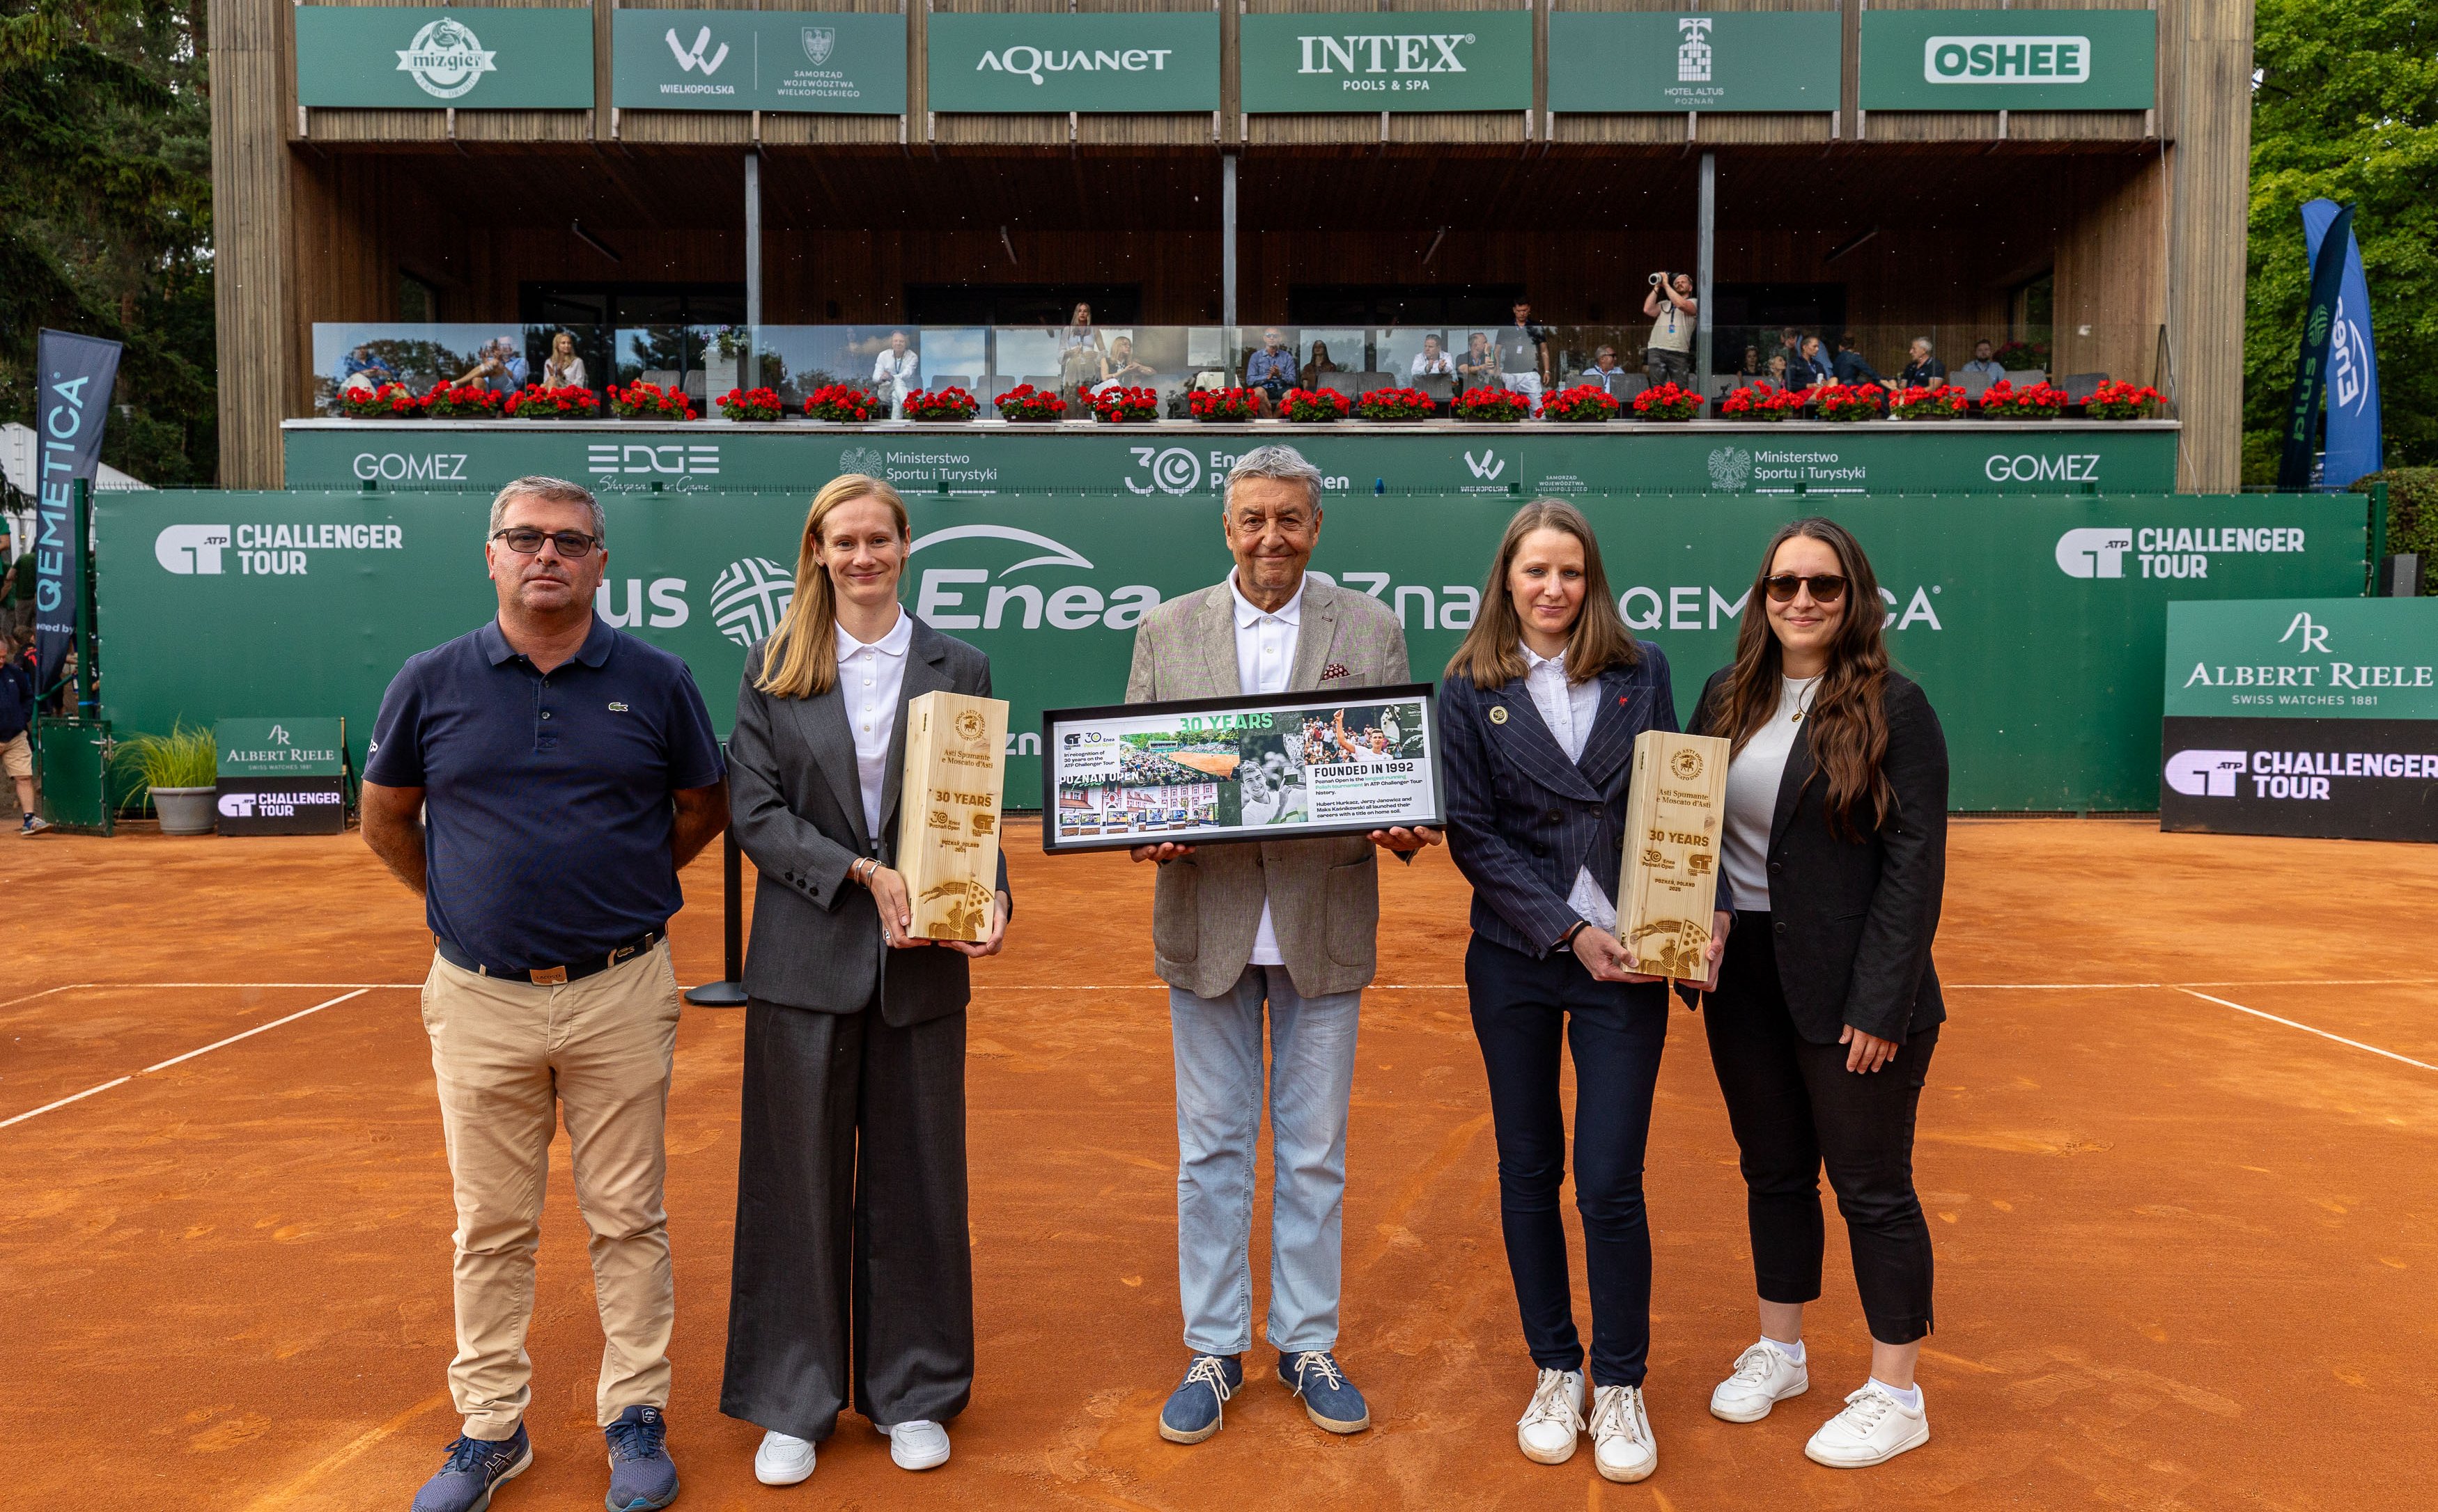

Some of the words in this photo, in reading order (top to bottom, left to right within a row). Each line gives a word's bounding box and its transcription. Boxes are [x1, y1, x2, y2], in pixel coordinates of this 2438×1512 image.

[413, 52, 481, 70] mizgier
[1934, 43, 2080, 77] OSHEE
[794, 70, 843, 79] SAMORZĄD
[660, 84, 735, 94] WIELKOPOLSKA
[784, 78, 854, 88] WOJEWÓDZTWA
[1343, 80, 1385, 91] POOLS
[1391, 80, 1401, 91] &
[1406, 80, 1429, 91] SPA
[777, 88, 860, 98] WIELKOPOLSKIEGO
[1664, 87, 1694, 95] HOTEL
[1695, 87, 1724, 95] ALTUS
[588, 445, 720, 474] EDGE
[886, 451, 970, 464] Ministerstwo
[1755, 451, 1839, 463] Ministerstwo
[353, 453, 468, 480] GOMEZ
[1754, 467, 1797, 481] Sportu
[1801, 467, 1804, 478] i
[1808, 466, 1866, 481] Turystyki
[1985, 454, 2101, 482] GOMEZ
[886, 468, 929, 482] Sportu
[932, 468, 935, 479] i
[939, 468, 997, 483] Turystyki
[676, 476, 711, 492] Game
[203, 536, 228, 545] ATP
[237, 524, 403, 549] CHALLENGER
[2138, 527, 2305, 552] CHALLENGER
[2105, 540, 2129, 549] ATP
[237, 550, 308, 575] TOUR
[2138, 554, 2208, 579] TOUR
[596, 577, 690, 628] us
[916, 568, 1161, 630] Enea
[2183, 662, 2321, 689] ALBERT
[2328, 662, 2434, 689] RIELE
[2232, 694, 2274, 705] SWISS
[2278, 695, 2345, 706] WATCHES
[2352, 696, 2378, 706] 1881
[1180, 717, 1202, 733] 30
[1208, 712, 1273, 731] YEARS
[226, 749, 286, 763] ALBERT
[290, 749, 334, 763] RIELE
[947, 757, 975, 766] Moscato
[976, 761, 993, 769] d'Asti
[958, 751, 991, 761] Spumante
[1314, 765, 1368, 778] FOUNDED
[1372, 764, 1383, 774] IN
[1385, 762, 1414, 774] 1992
[2216, 761, 2243, 770] ATP
[2252, 751, 2438, 779] CHALLENGER
[1109, 771, 1140, 781] OPEN
[1673, 790, 1709, 800] Spumante
[2253, 775, 2330, 800] TOUR
[258, 792, 341, 804] CHALLENGER
[936, 790, 950, 802] 30
[954, 793, 992, 807] YEARS
[1662, 797, 1691, 806] Moscato
[258, 804, 295, 817] TOUR
[1649, 830, 1665, 842] 30
[1669, 832, 1709, 847] YEARS
